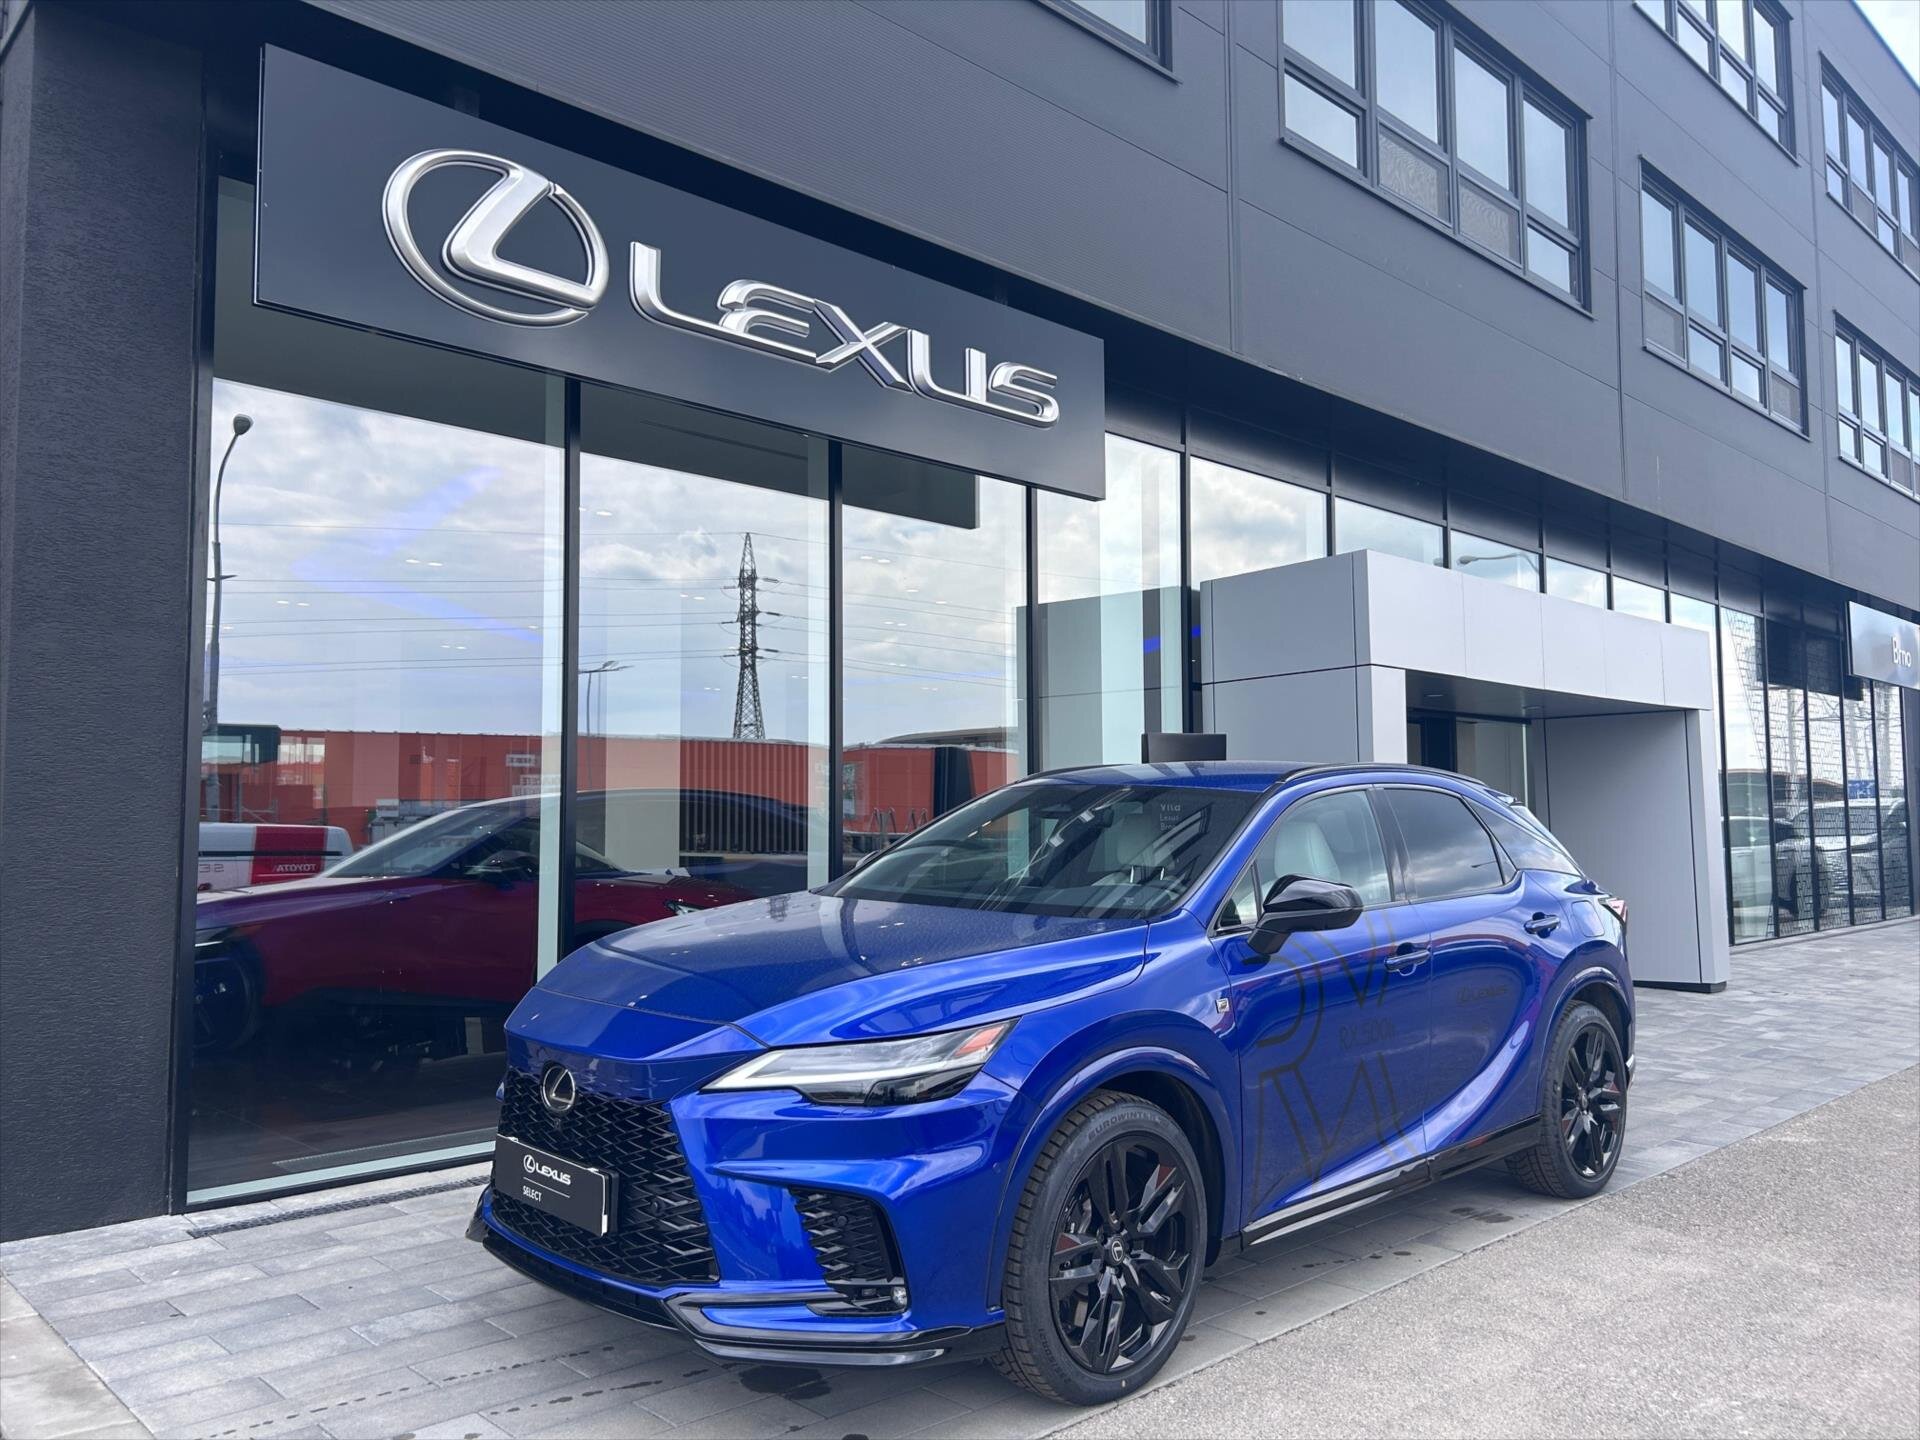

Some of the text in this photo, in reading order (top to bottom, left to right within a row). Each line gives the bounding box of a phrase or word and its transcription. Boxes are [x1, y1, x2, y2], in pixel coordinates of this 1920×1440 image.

[630, 242, 1060, 429] LEXUS
[1892, 636, 1912, 668] Brno
[536, 1162, 571, 1185] LEXUS
[523, 1186, 542, 1202] SELECT
